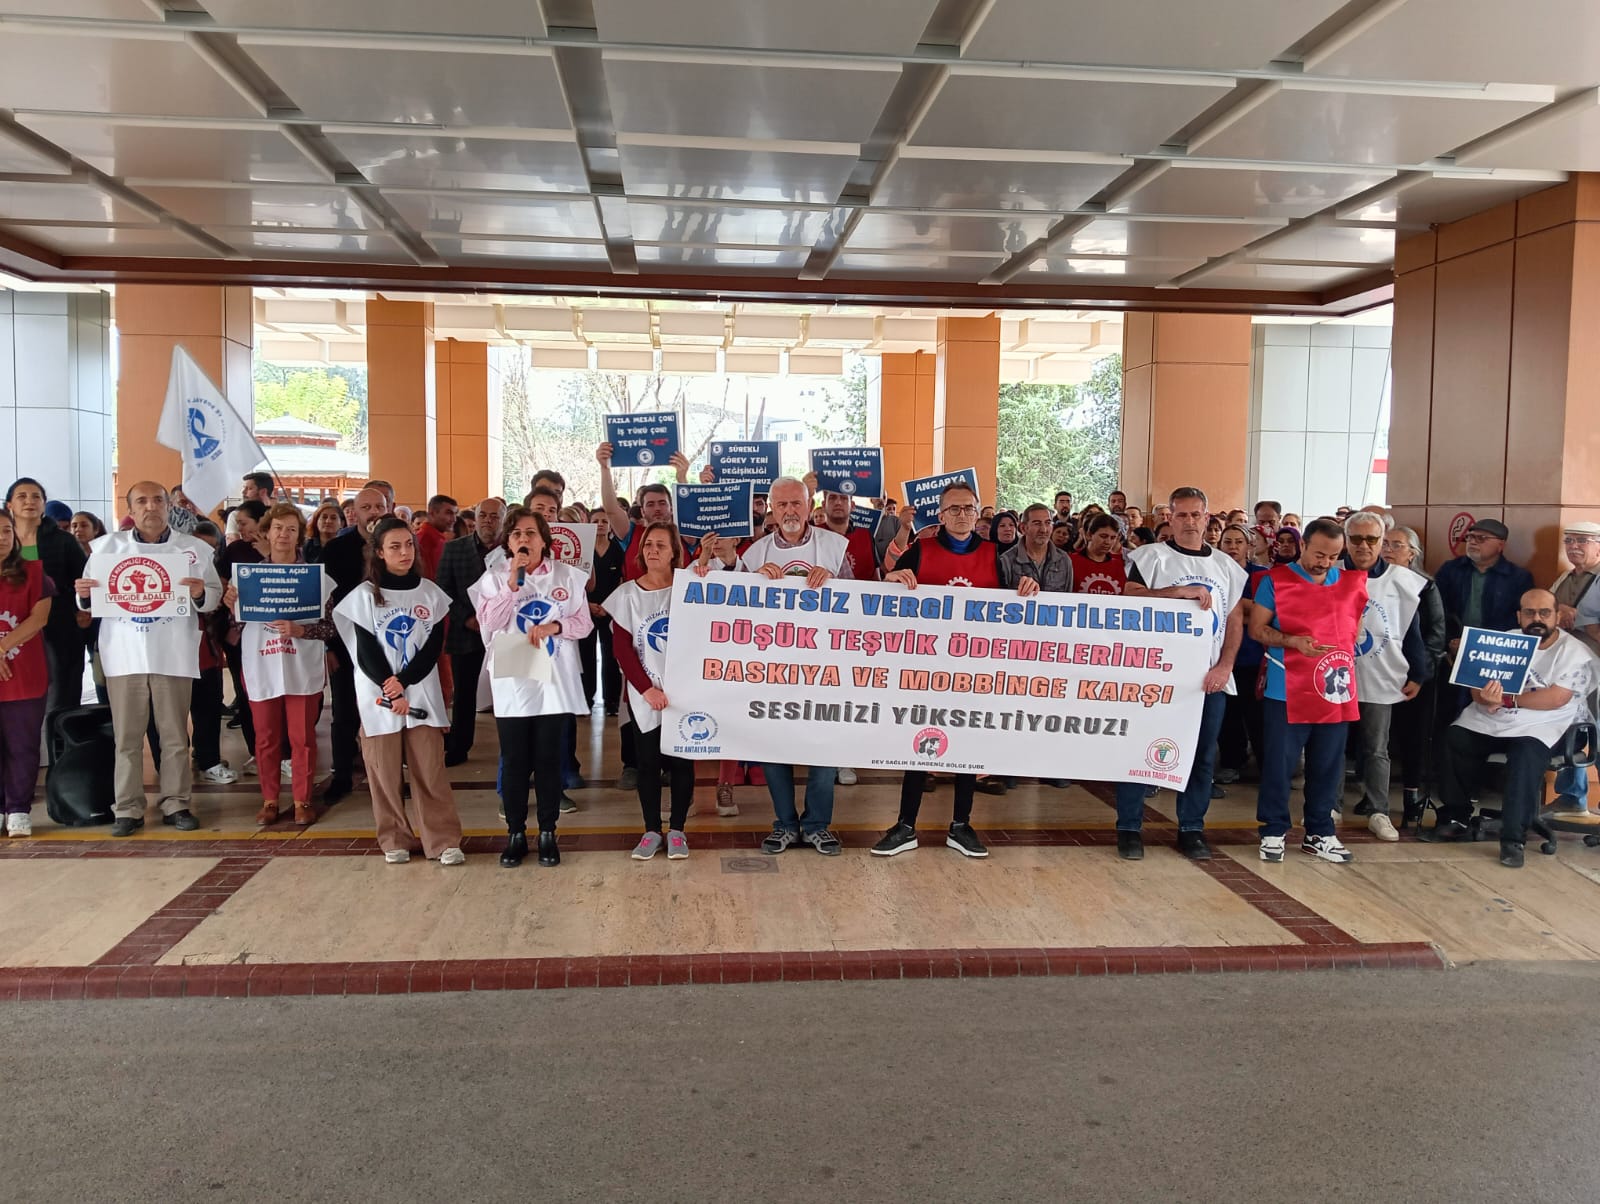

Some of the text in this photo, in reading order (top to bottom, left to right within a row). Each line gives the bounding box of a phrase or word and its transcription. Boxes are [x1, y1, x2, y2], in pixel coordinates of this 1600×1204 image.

[728, 445, 760, 453] SÜREKLİ
[720, 456, 747, 464] GÖREV
[108, 592, 171, 602] VERGİDE ADALET
[683, 582, 1203, 636] ADALETSİZ VERGİ KESİNTİLERİNE,
[710, 618, 1173, 672] DÜŞÜK TEŞVİK ÖDEMELERİNE,
[1477, 634, 1529, 650] ANGARYA
[1468, 650, 1527, 666] ÇALIŞMAYA
[702, 658, 1174, 707] BASKIYA VE MOBBİNGE KARŞI
[1479, 668, 1514, 681] HAYIR!
[748, 700, 1129, 736] SESİMİZİ YÜKSELTİYORUZ!
